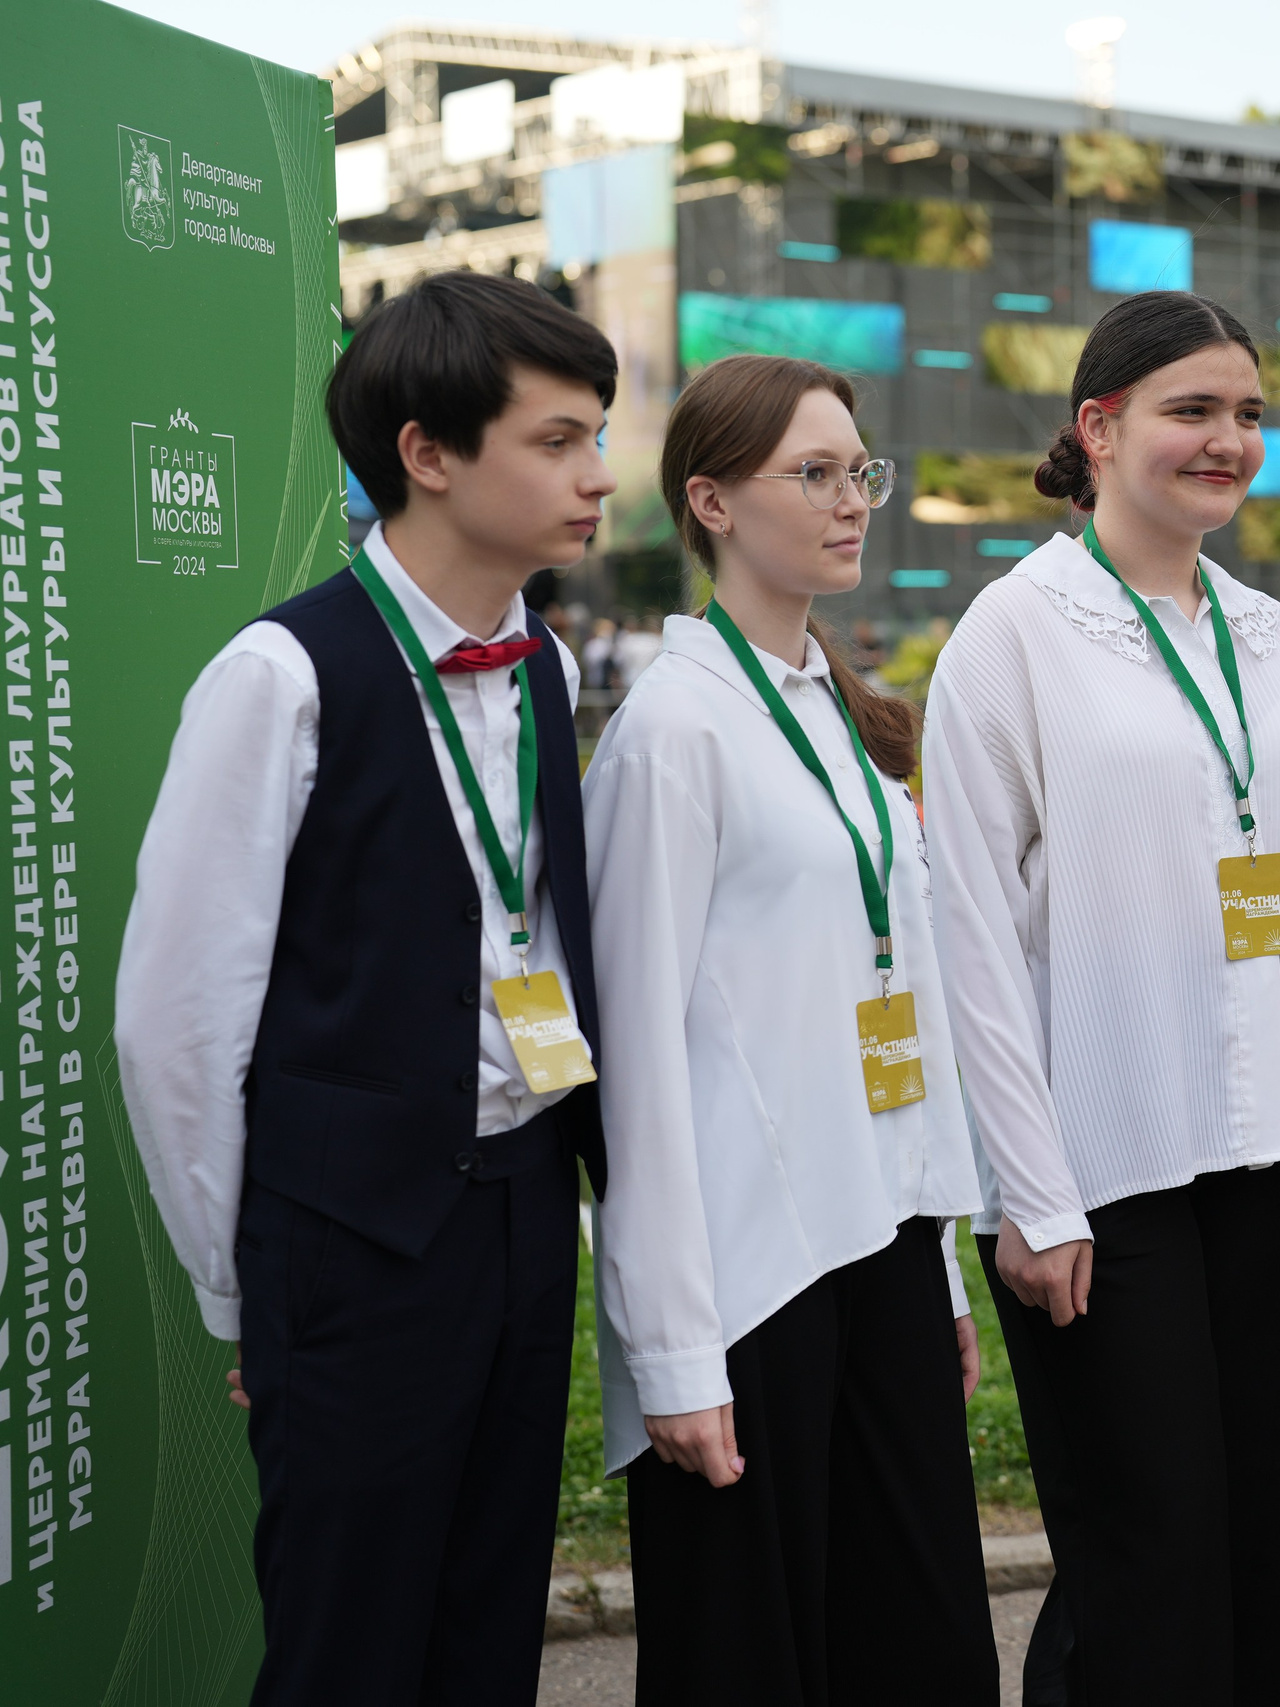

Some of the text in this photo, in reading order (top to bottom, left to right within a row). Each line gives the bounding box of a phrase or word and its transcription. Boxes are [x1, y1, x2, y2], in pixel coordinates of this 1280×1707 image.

[181, 151, 263, 194] Департамент
[183, 187, 239, 219] культуры
[184, 218, 276, 255] города Москвы
[150, 445, 218, 472] ГРАНТЫ
[151, 467, 220, 508] МЭРА
[152, 507, 222, 536] МОСКВЫ
[0, 377, 34, 722] ЛАУРЕАТОВ
[173, 555, 206, 576] 2024
[17, 100, 93, 1532] МЭРА МОСКВЫ В СФЕРЕ КУЛЬТУРЫ И ИСКУССТВА
[1221, 890, 1241, 899] 01.06
[9, 739, 47, 1182] НАГРАЖДЕНИЯ
[506, 1015, 578, 1041] УЧАСТНИК
[860, 1035, 878, 1048] 01.06
[860, 1035, 919, 1060] УЧАСТНИК
[23, 1196, 58, 1572] ЦЕРЕМОНИЯ
